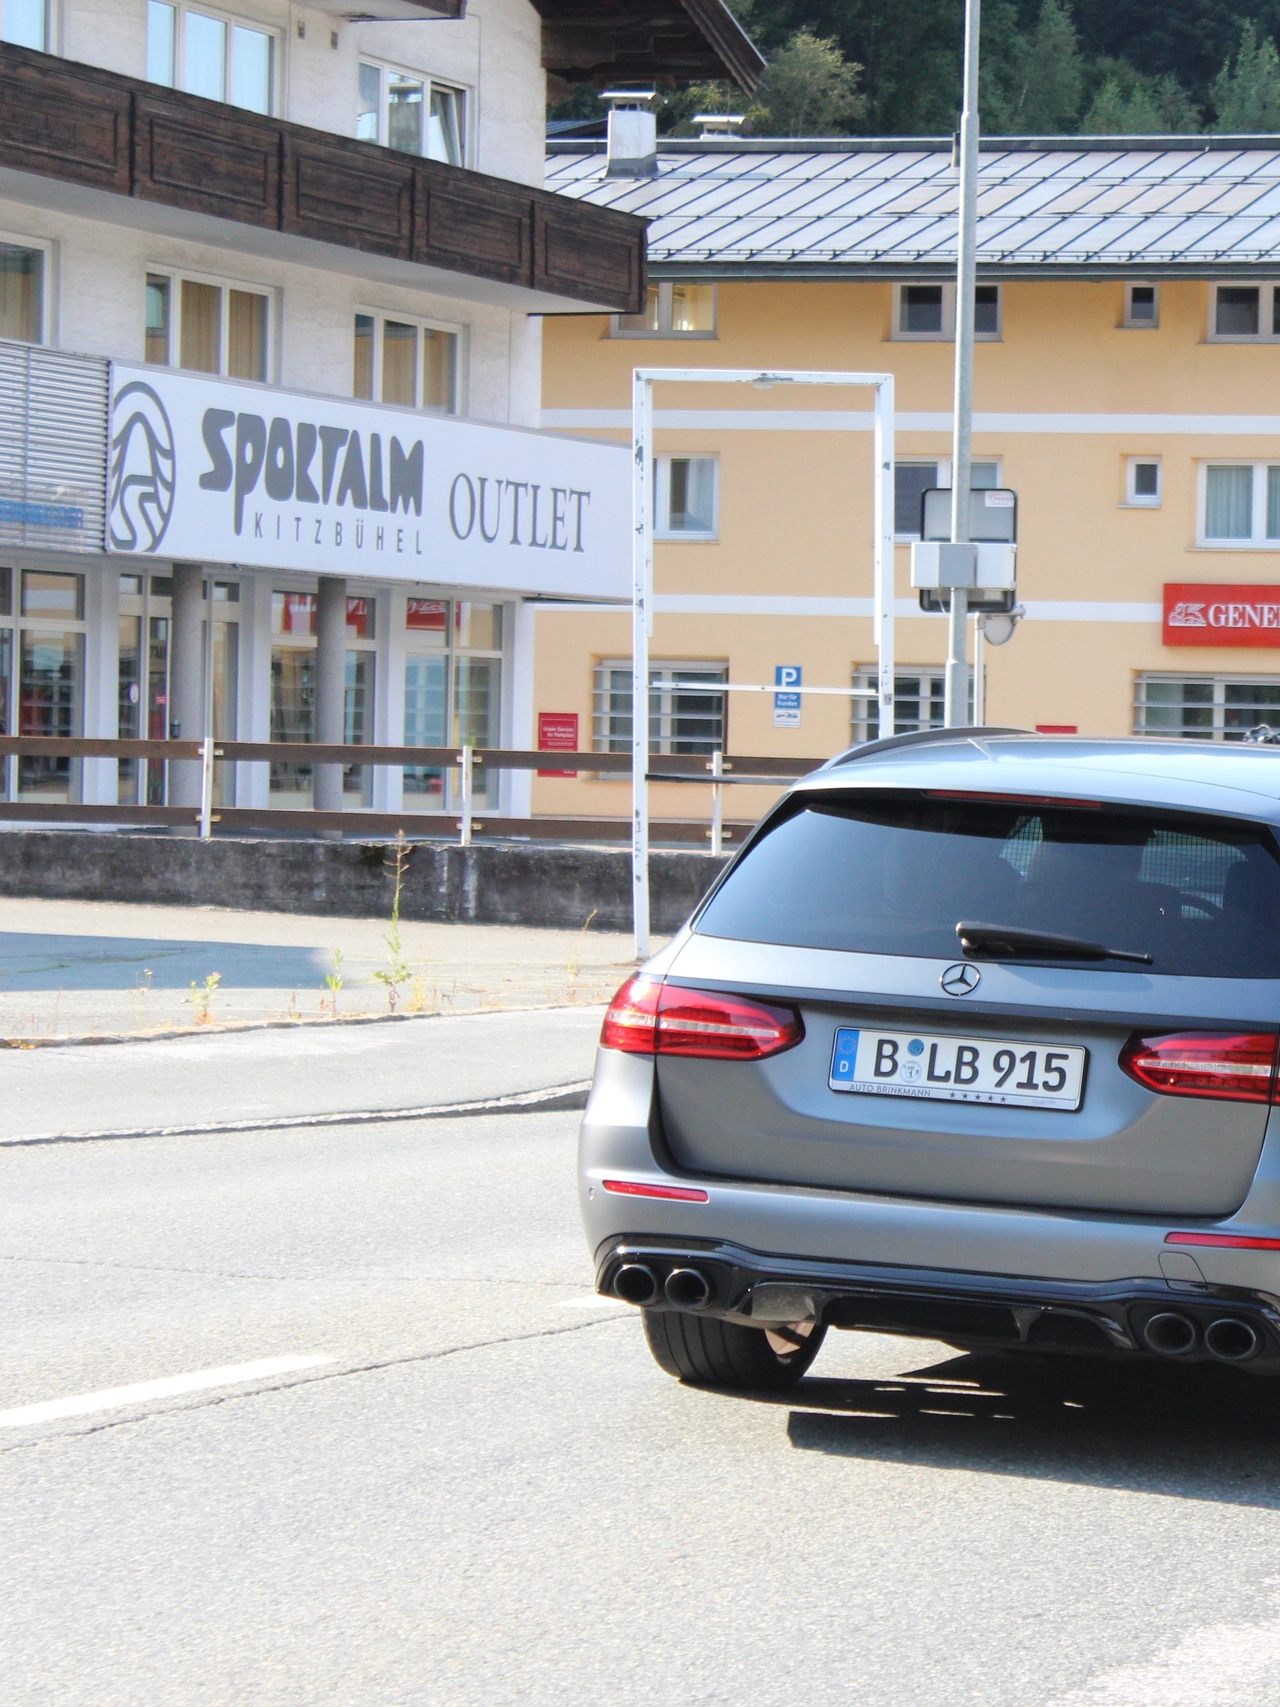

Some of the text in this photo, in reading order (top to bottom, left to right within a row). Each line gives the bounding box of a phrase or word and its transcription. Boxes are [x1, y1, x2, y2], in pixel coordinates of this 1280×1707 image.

[198, 407, 425, 537] SPORTALM
[253, 511, 422, 556] KITZBÜHEL
[449, 472, 591, 553] OUTLET
[780, 667, 798, 687] P
[839, 1060, 849, 1073] D
[873, 1038, 1070, 1093] B LB 915
[848, 1083, 932, 1097] AUTO BRINKMANN
